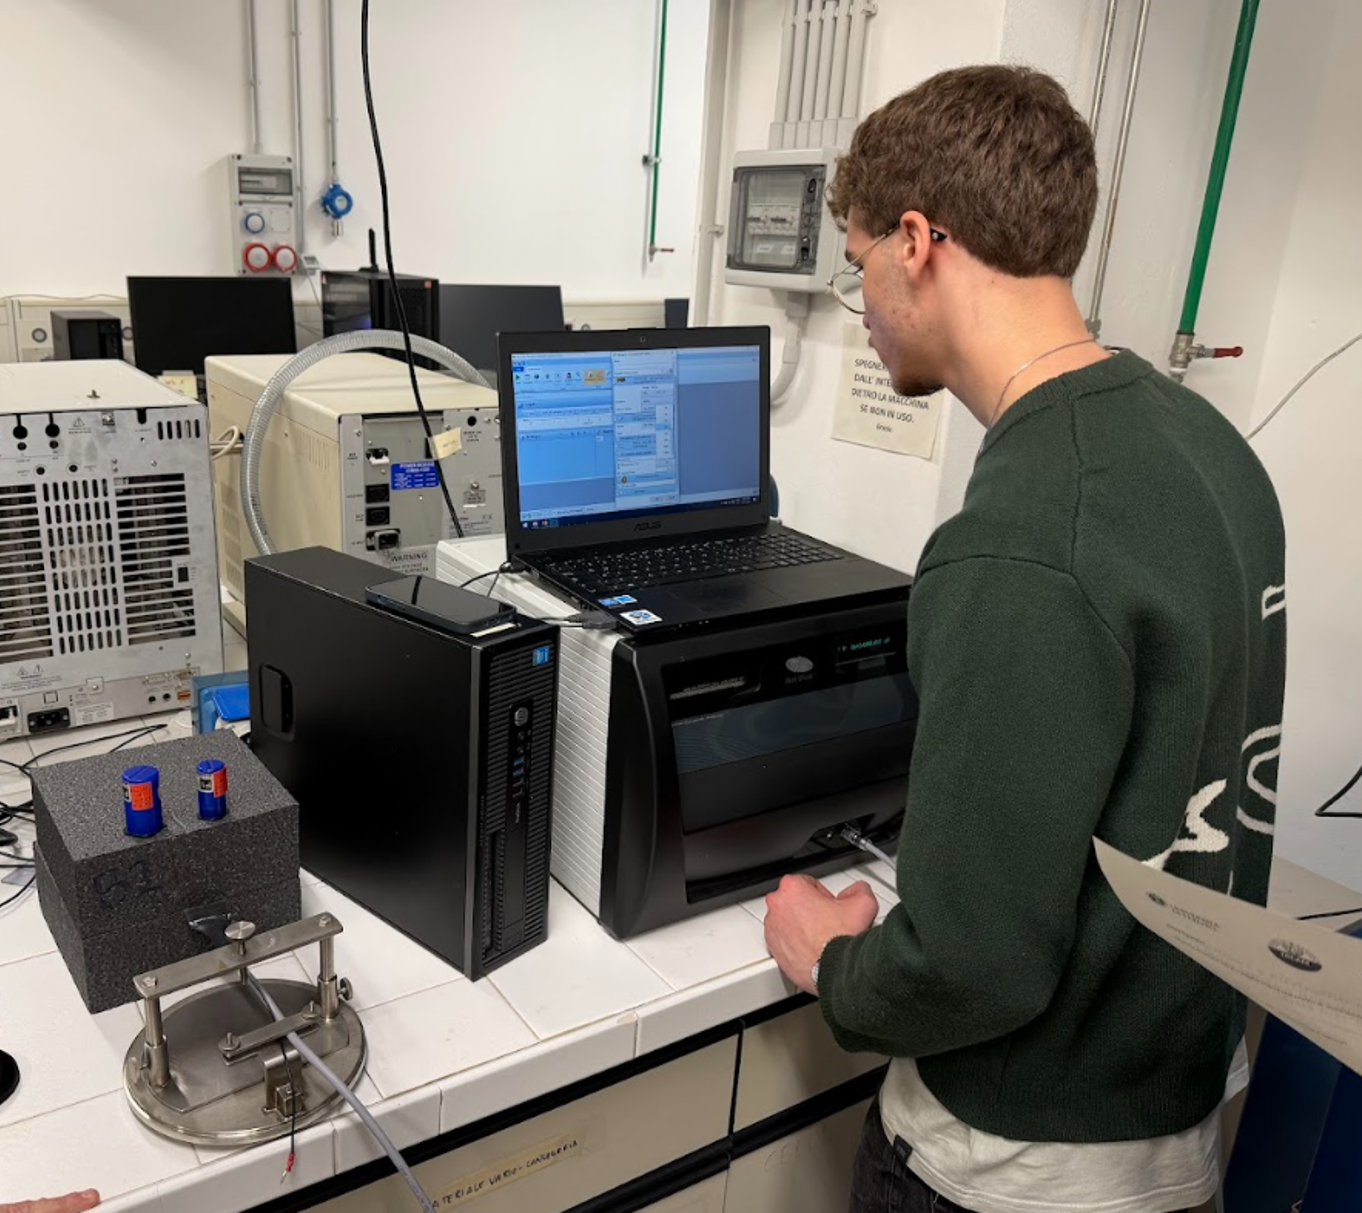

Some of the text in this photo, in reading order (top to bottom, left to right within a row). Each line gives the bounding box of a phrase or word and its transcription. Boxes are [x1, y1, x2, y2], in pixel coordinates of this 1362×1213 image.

[875, 376, 892, 388] INTE
[851, 387, 930, 411] DIETRO LA MACCHINA
[859, 403, 869, 414] SE
[869, 405, 887, 417] NON
[887, 408, 896, 419] IN
[390, 552, 428, 562] WARNING
[431, 1180, 485, 1209] ATERIALE
